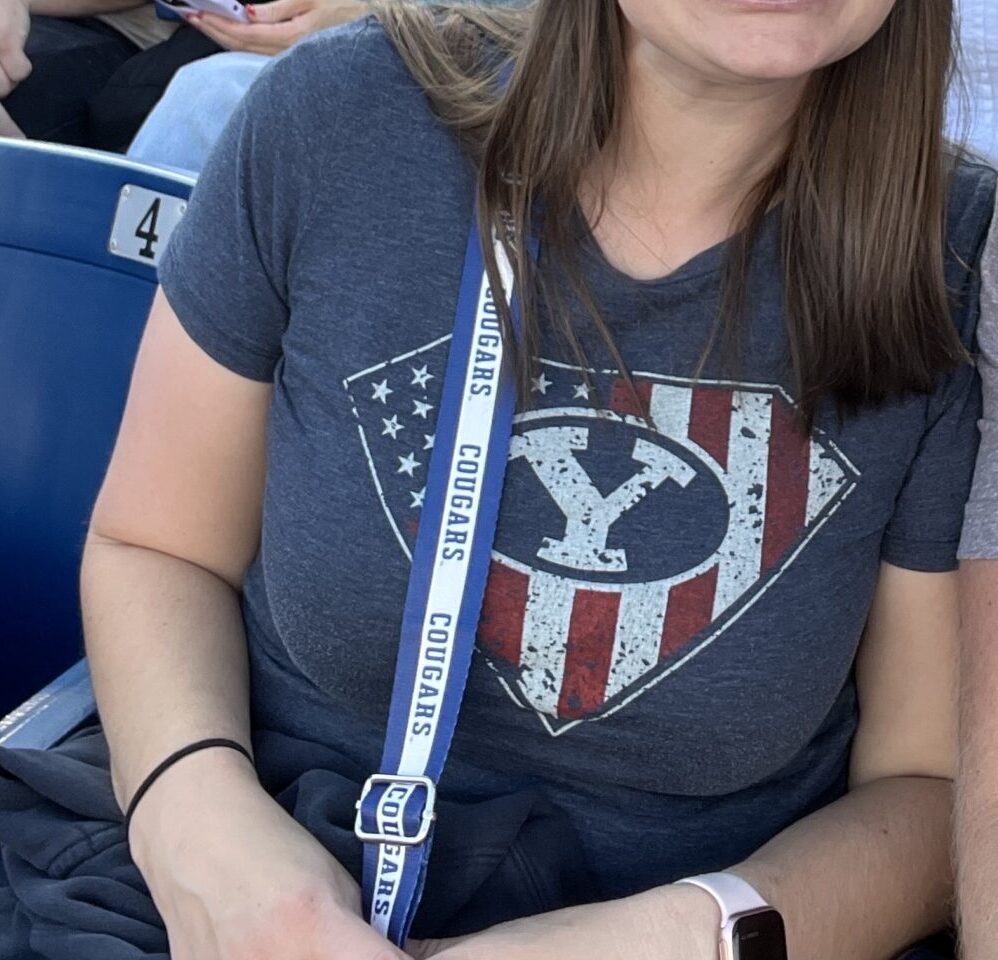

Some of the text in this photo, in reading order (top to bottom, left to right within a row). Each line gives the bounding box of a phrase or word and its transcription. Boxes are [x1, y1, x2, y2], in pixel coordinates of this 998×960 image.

[135, 197, 161, 260] 4
[442, 443, 481, 562] COUGARS
[507, 426, 697, 572] Y
[412, 612, 452, 737] COUGARS
